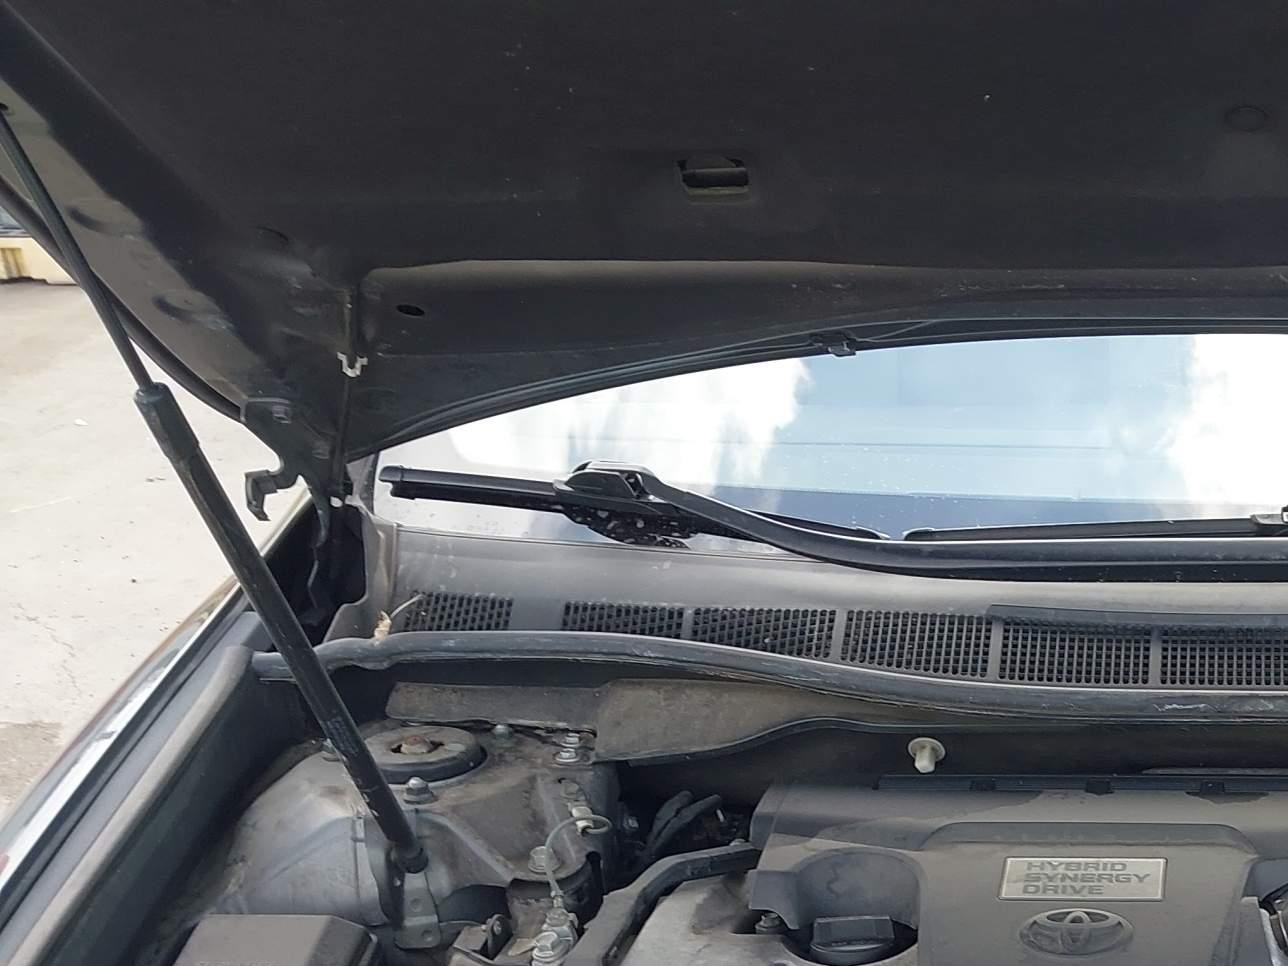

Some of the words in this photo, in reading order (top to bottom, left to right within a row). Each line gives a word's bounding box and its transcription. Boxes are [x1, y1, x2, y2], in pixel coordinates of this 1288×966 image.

[1026, 861, 1128, 872] HYBRID
[1023, 872, 1151, 884] SYNERGY
[1022, 884, 1105, 895] DRIVE
